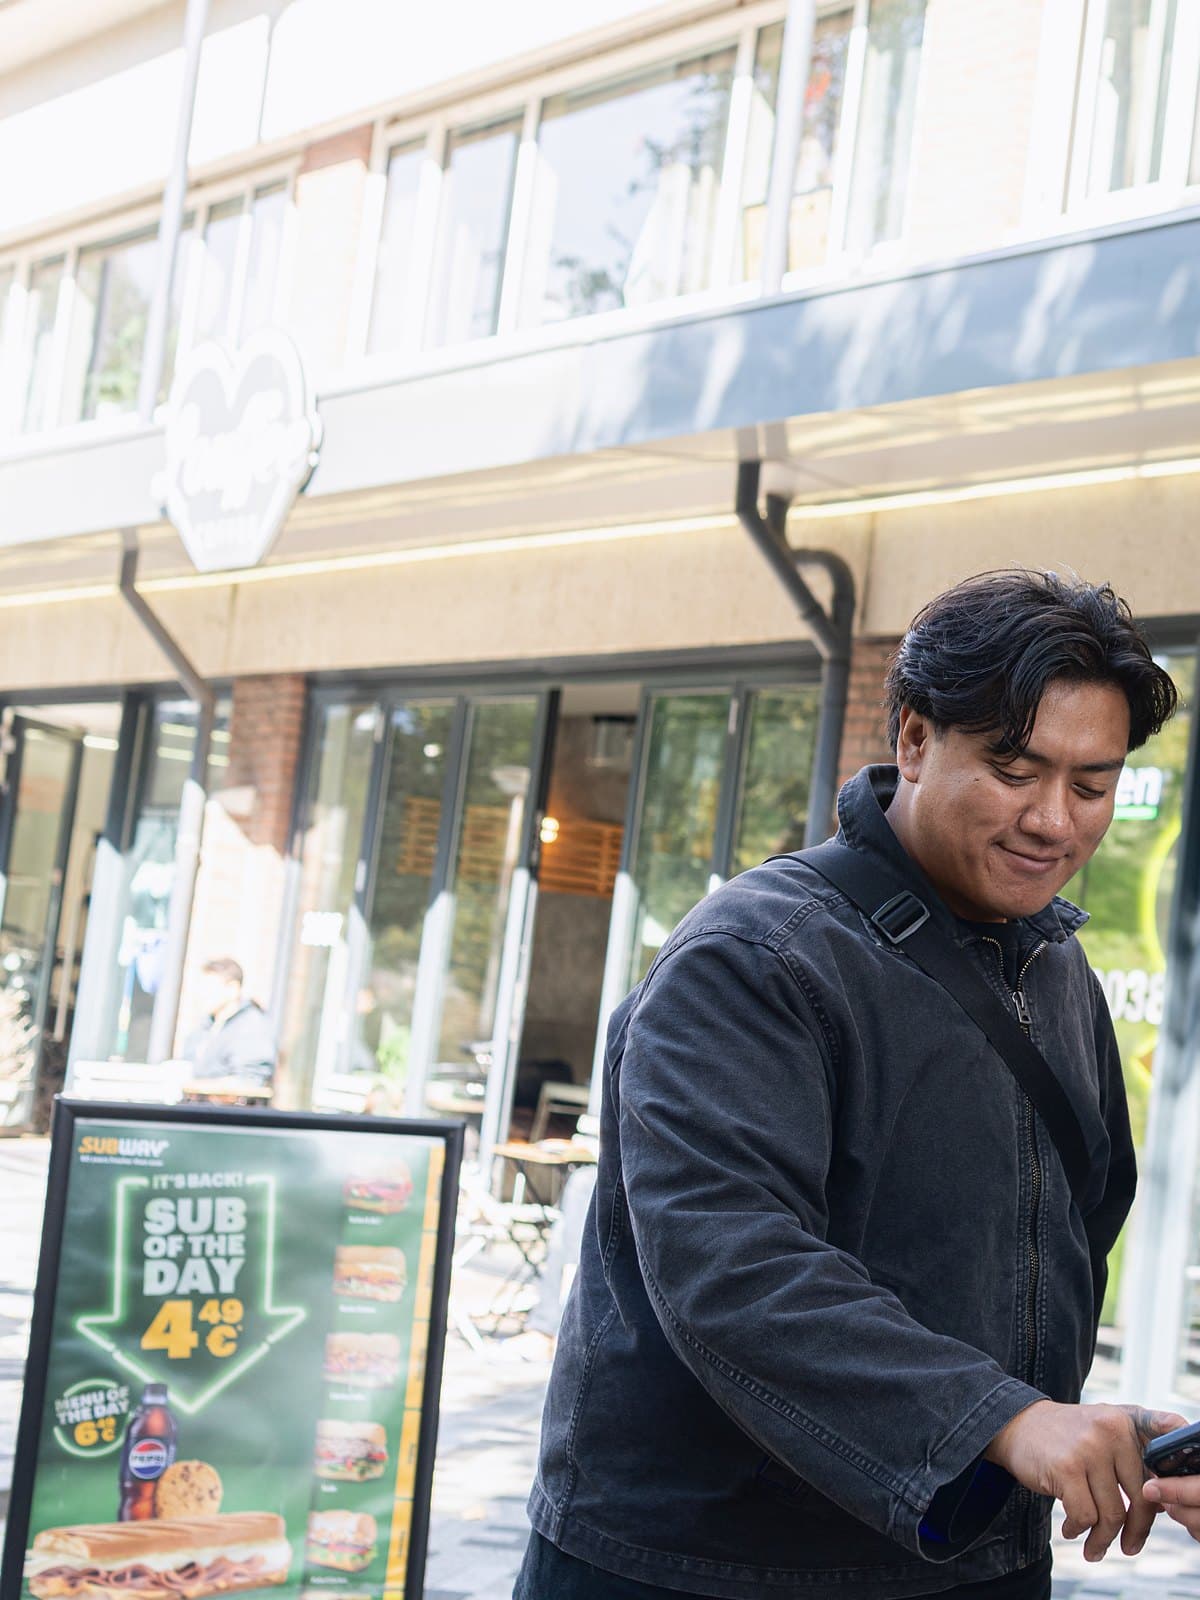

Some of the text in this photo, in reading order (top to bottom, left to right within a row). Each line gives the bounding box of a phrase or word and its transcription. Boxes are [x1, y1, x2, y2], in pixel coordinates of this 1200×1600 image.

[1093, 968, 1165, 1025] 038
[79, 1136, 169, 1157] SUBWAY
[153, 1171, 244, 1190] IT'S BACK!
[143, 1197, 247, 1235] SUB
[143, 1233, 246, 1258] OF THE
[142, 1257, 245, 1296] DAY
[55, 1386, 129, 1411] MENU OF
[56, 1399, 129, 1425] THE DAY
